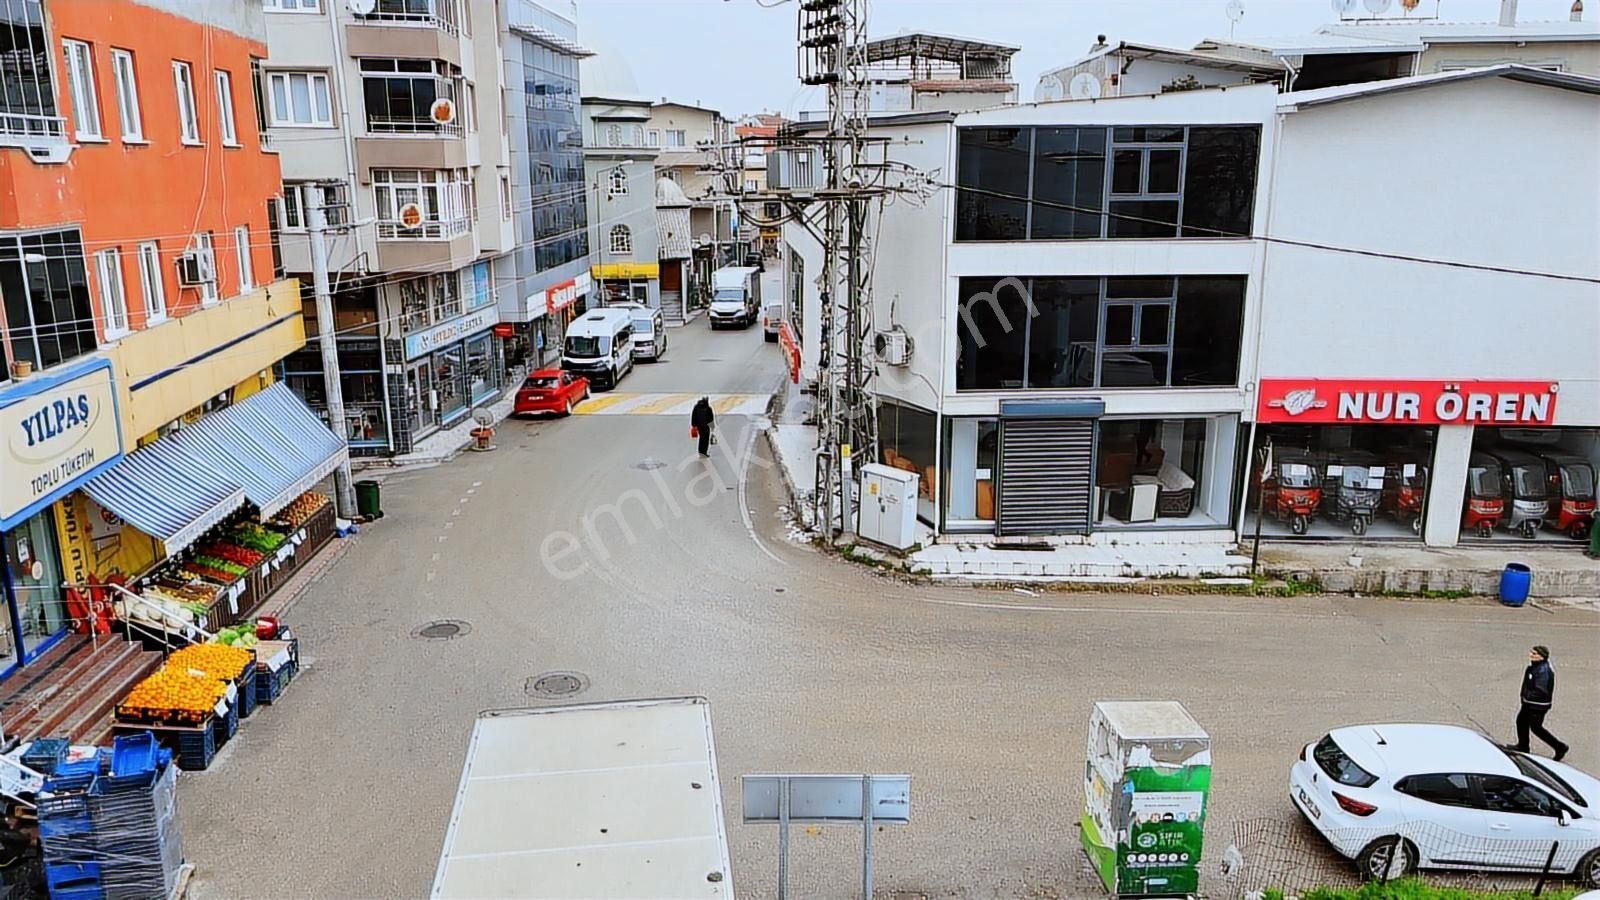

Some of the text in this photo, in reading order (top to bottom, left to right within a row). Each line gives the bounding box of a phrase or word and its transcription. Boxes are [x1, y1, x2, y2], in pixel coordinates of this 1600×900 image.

[21, 394, 89, 446] YILPAŞ
[1337, 383, 1550, 421] NUR ÖREN
[31, 447, 95, 496] TOPLU TÜKETİM
[63, 497, 88, 595] OPLU TÜKE
